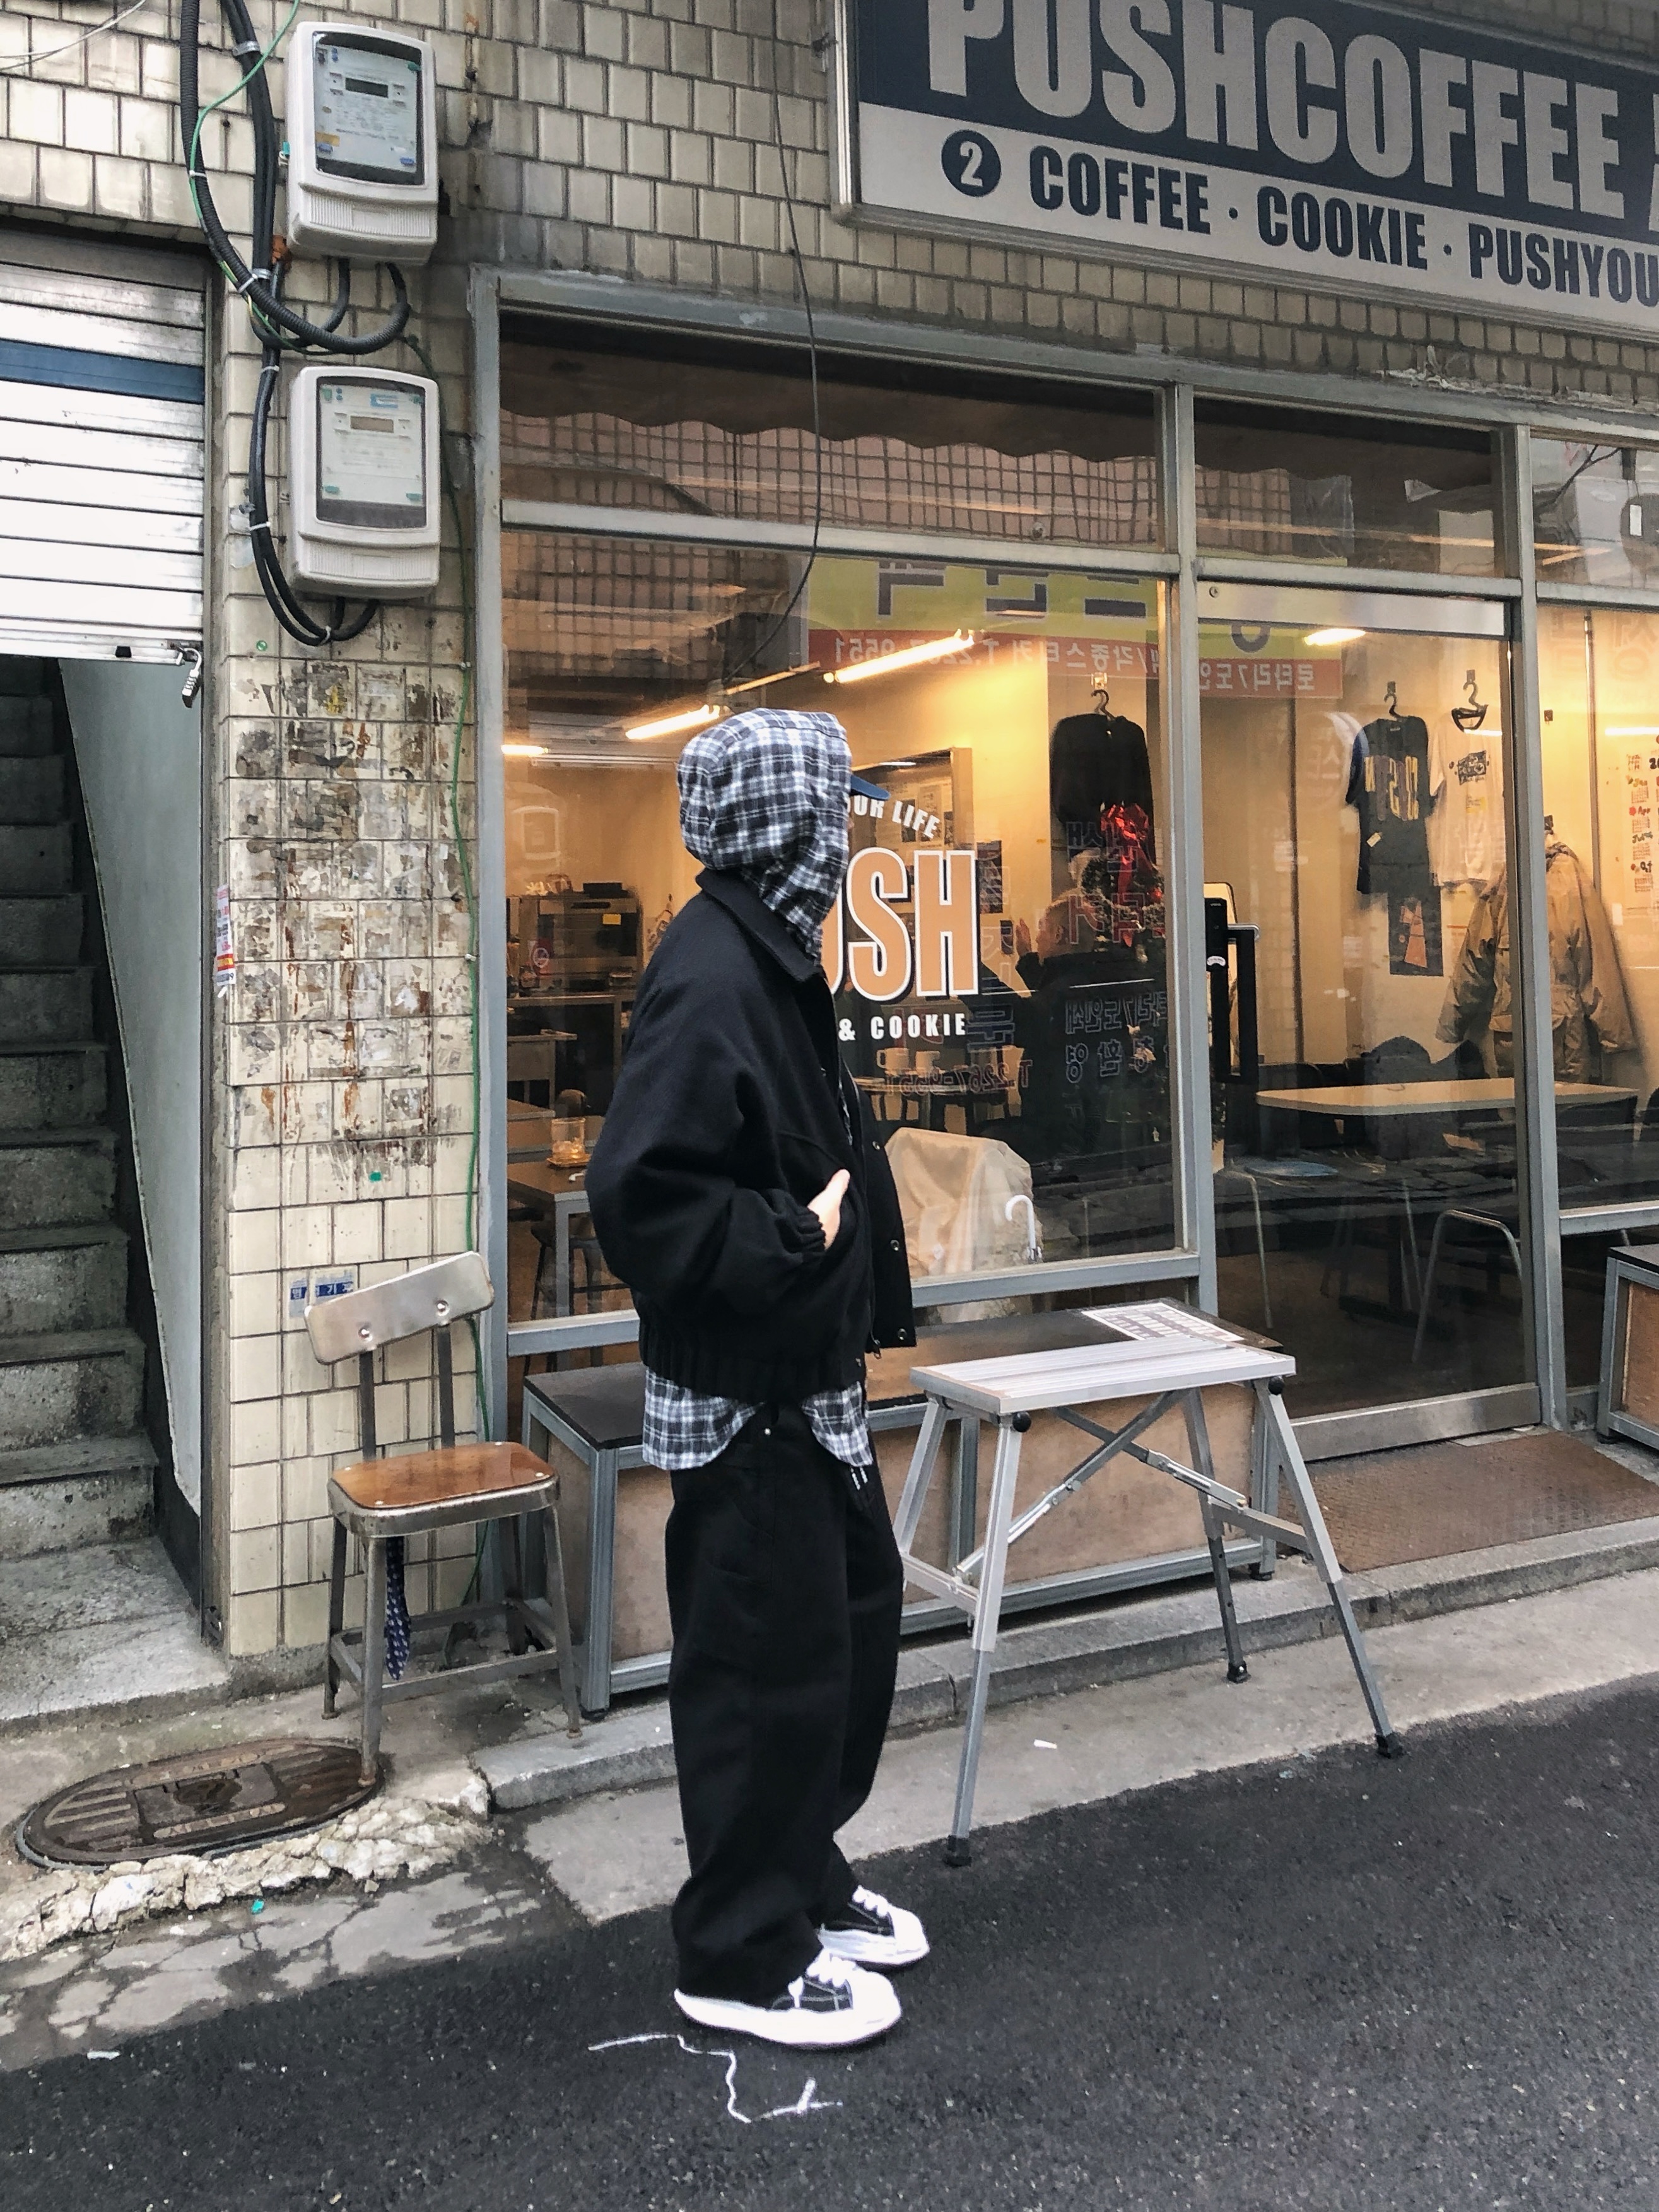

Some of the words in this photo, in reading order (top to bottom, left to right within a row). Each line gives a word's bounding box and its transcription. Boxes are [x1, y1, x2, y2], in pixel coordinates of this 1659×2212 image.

[928, 0, 1625, 220] PUSHCOFFEE
[1029, 145, 1211, 235] COFFEE
[1257, 185, 1428, 270] COOKIE
[891, 800, 941, 839] LIFE
[838, 1018, 856, 1041] &
[871, 1013, 966, 1040] COOKIE
